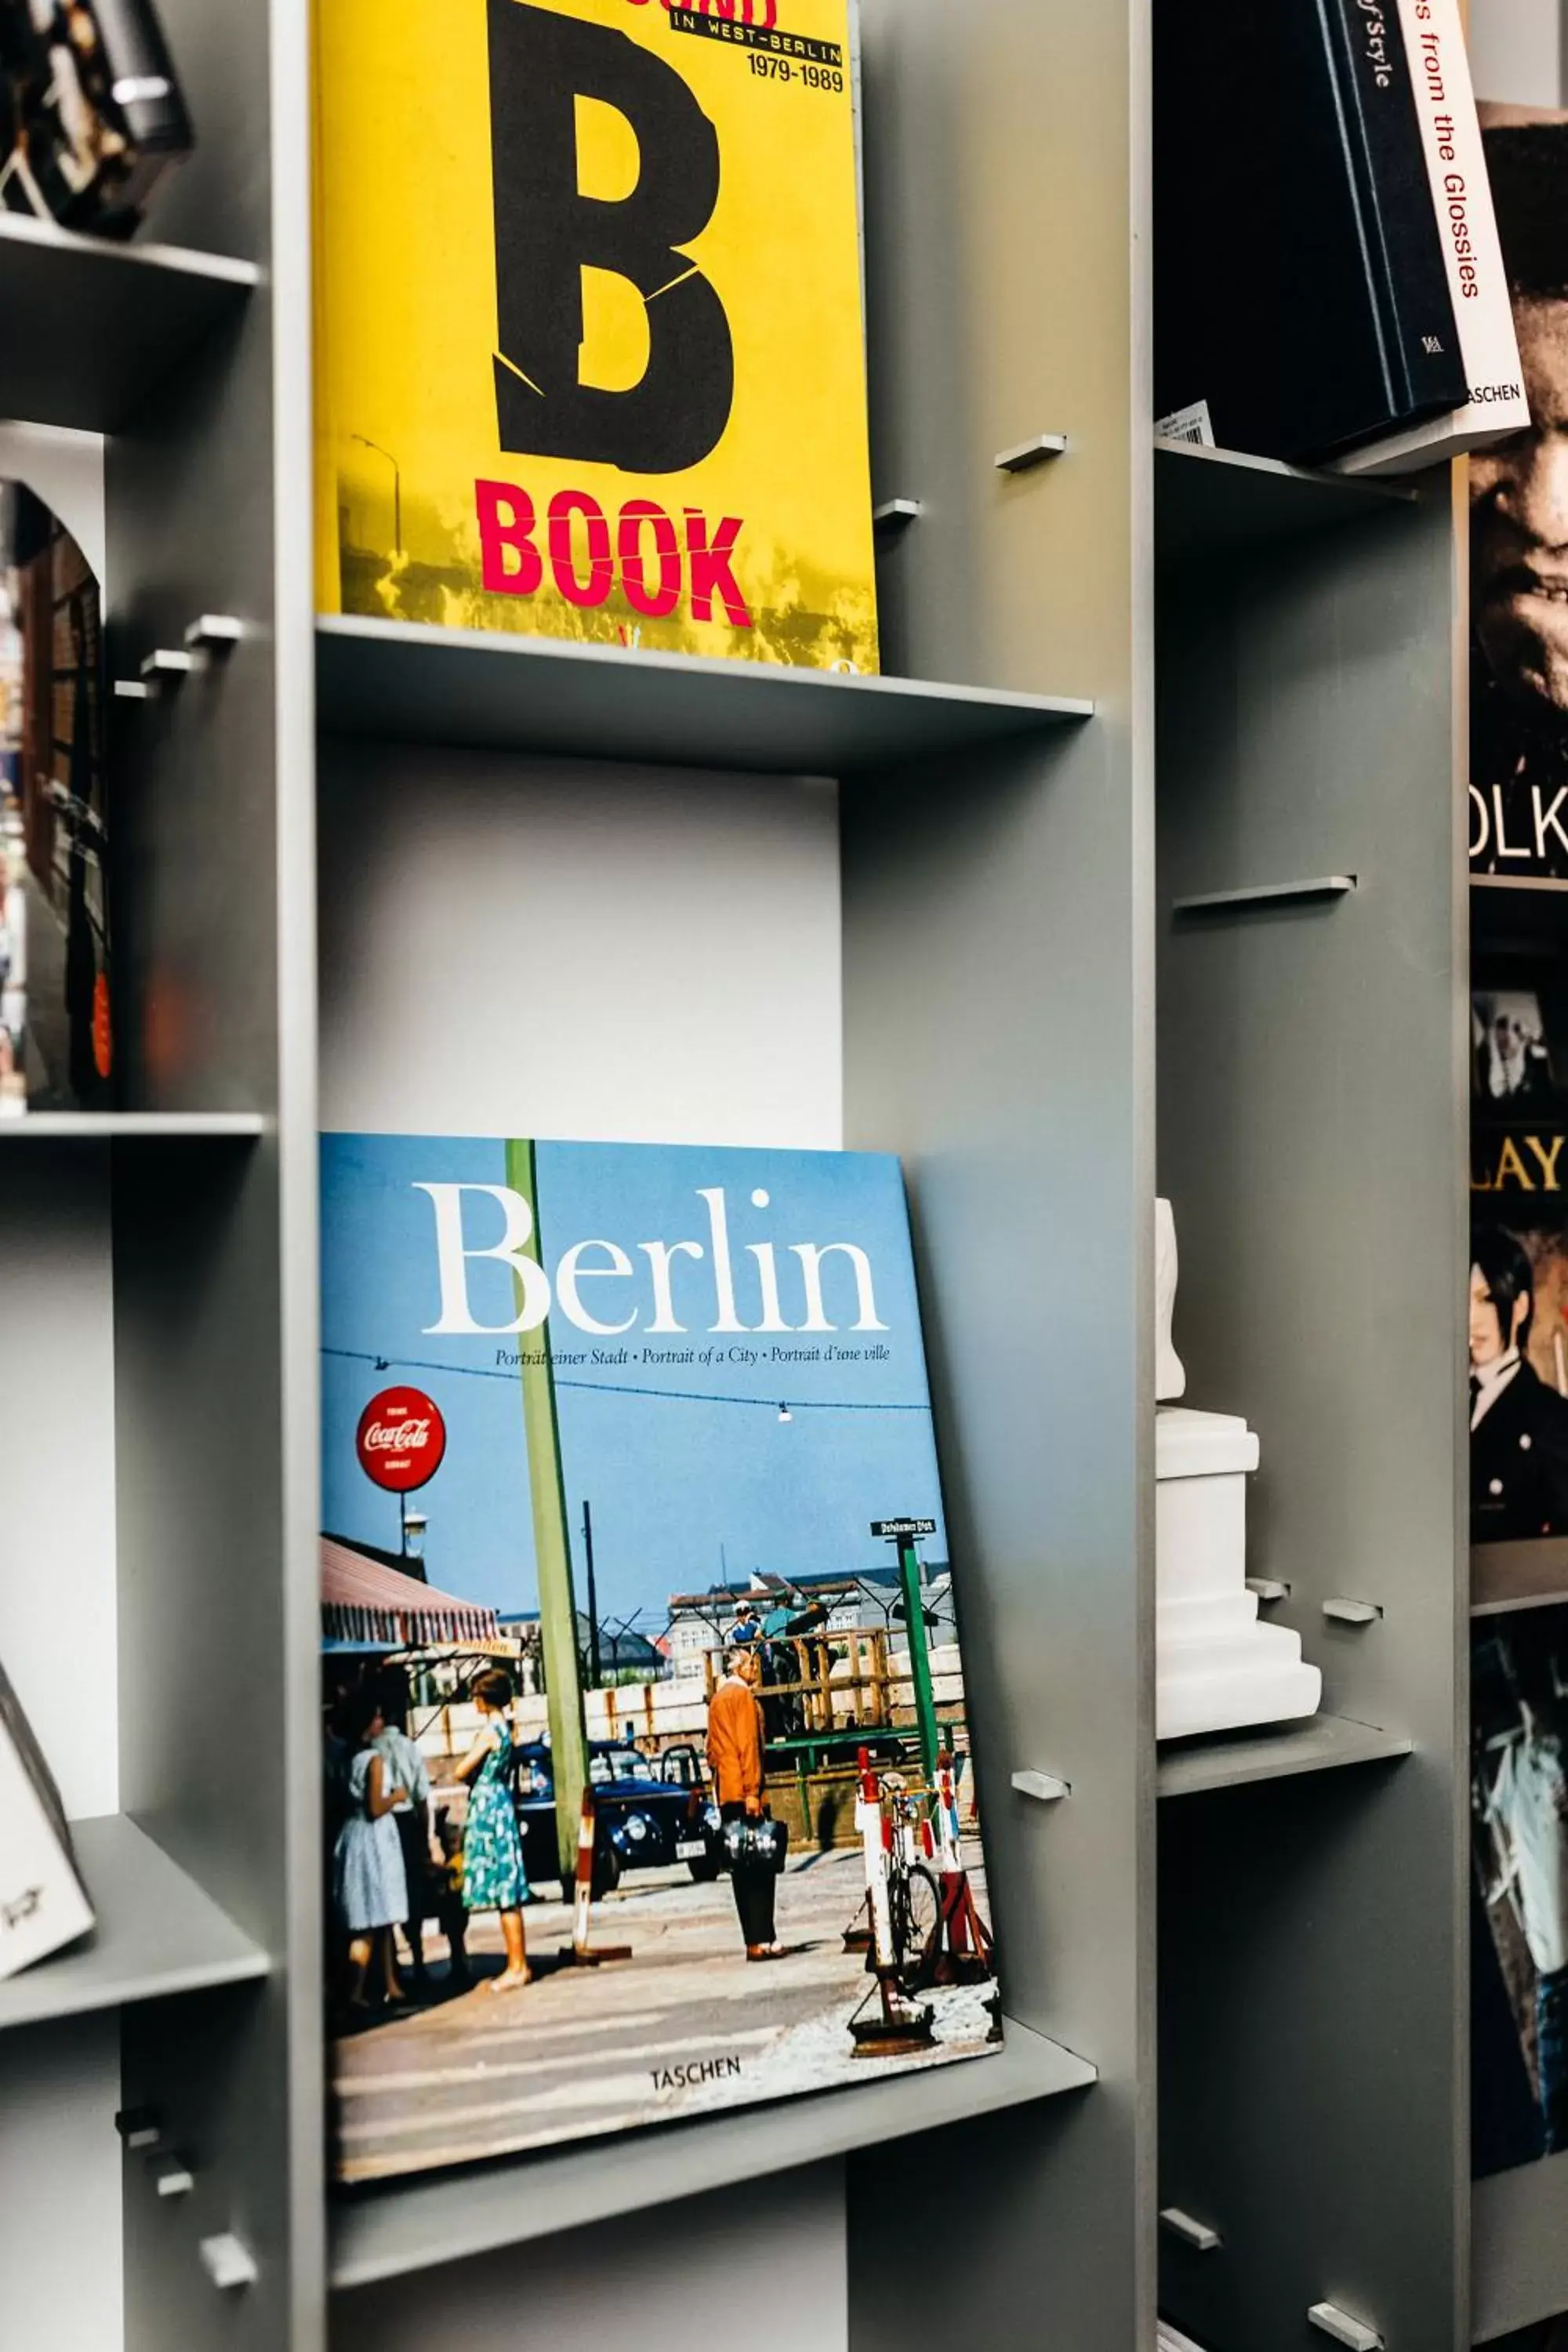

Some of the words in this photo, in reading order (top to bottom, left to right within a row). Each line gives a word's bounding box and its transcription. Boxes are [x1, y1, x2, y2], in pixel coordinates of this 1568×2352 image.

[673, 12, 695, 30] IN
[708, 20, 843, 63] WEST-BERLIN
[1365, 21, 1393, 87] Style
[1421, 32, 1445, 101] from
[747, 53, 844, 93] 1979-1989
[1434, 114, 1455, 162] the
[486, 0, 734, 474] B
[1443, 174, 1479, 298] Glossies
[475, 478, 752, 627] BOOK
[412, 1182, 890, 1335] Berlin
[495, 1348, 547, 1366] Porträt
[550, 1349, 587, 1365] einer
[590, 1347, 629, 1365] Stadt
[641, 1347, 695, 1365] Portrait
[698, 1346, 715, 1366] of
[716, 1352, 724, 1363] a
[728, 1345, 758, 1367] City
[770, 1345, 820, 1363] Portrait
[864, 1344, 891, 1362] ville
[650, 2053, 741, 2091] TASCHEN
